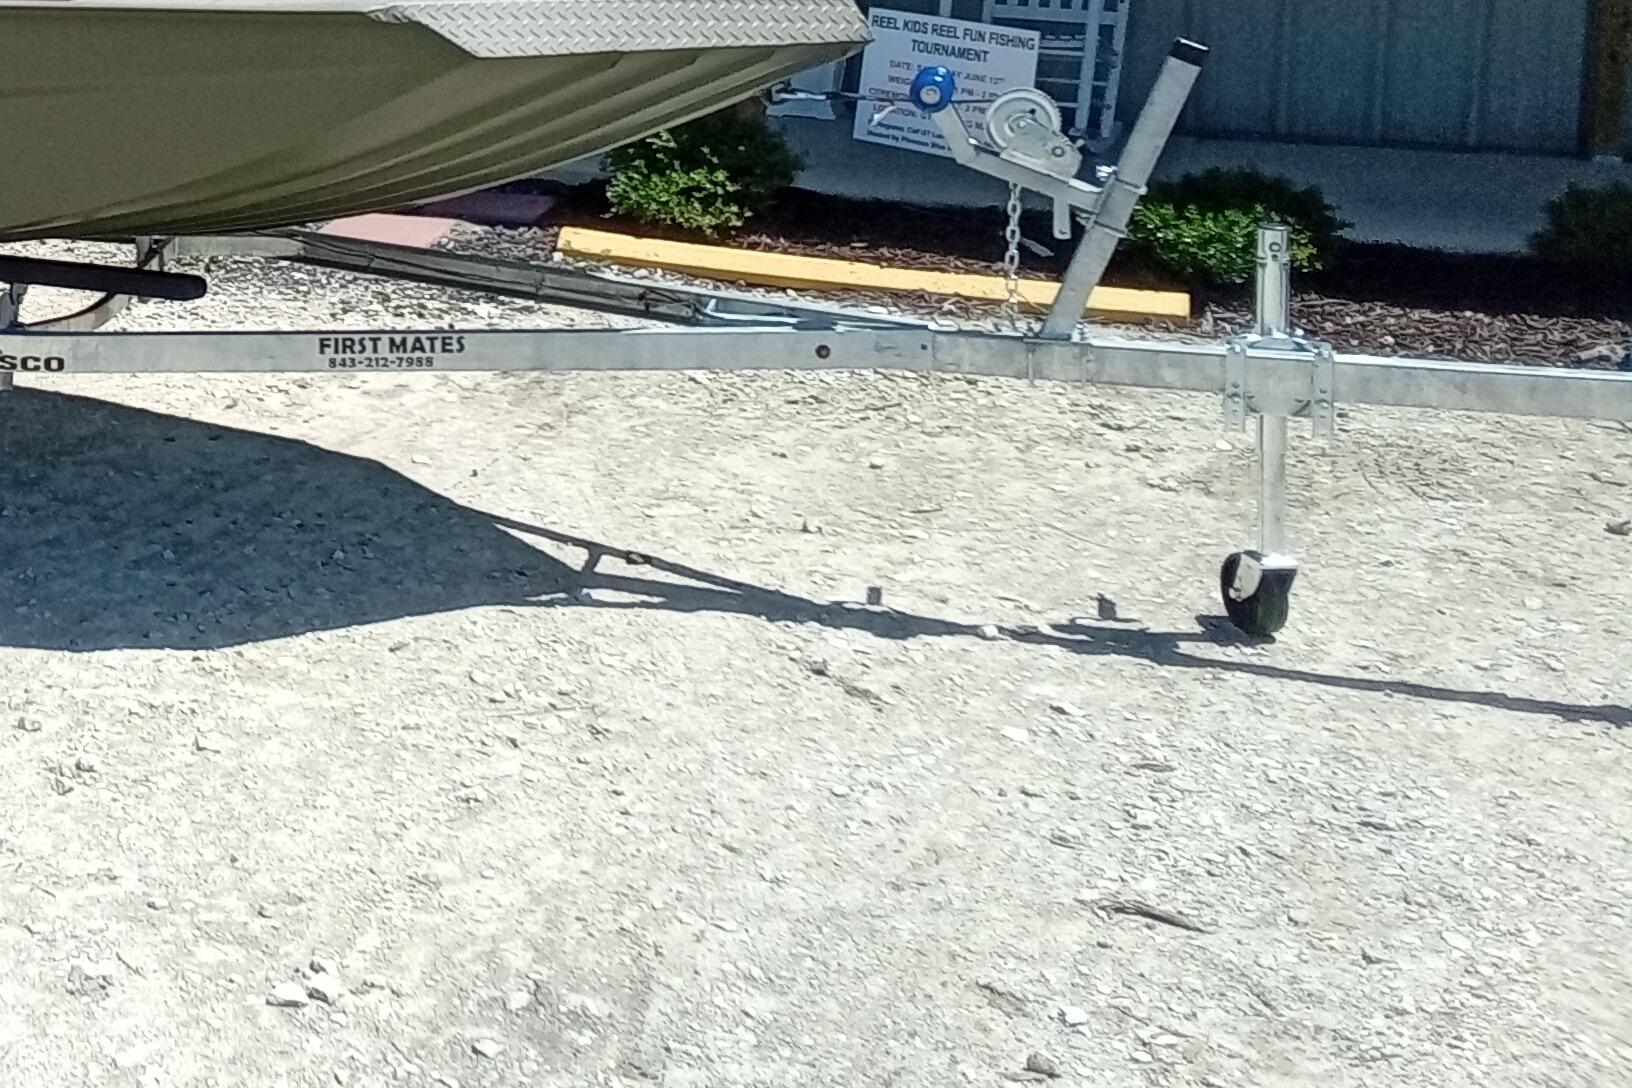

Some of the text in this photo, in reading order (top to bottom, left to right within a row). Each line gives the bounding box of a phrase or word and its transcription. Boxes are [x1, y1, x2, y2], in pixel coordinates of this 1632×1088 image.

[871, 14, 1036, 51] REEL KIDS REEL FUN FISHING
[911, 39, 990, 63] TOURNAMENT
[318, 335, 466, 355] FIRST MATES
